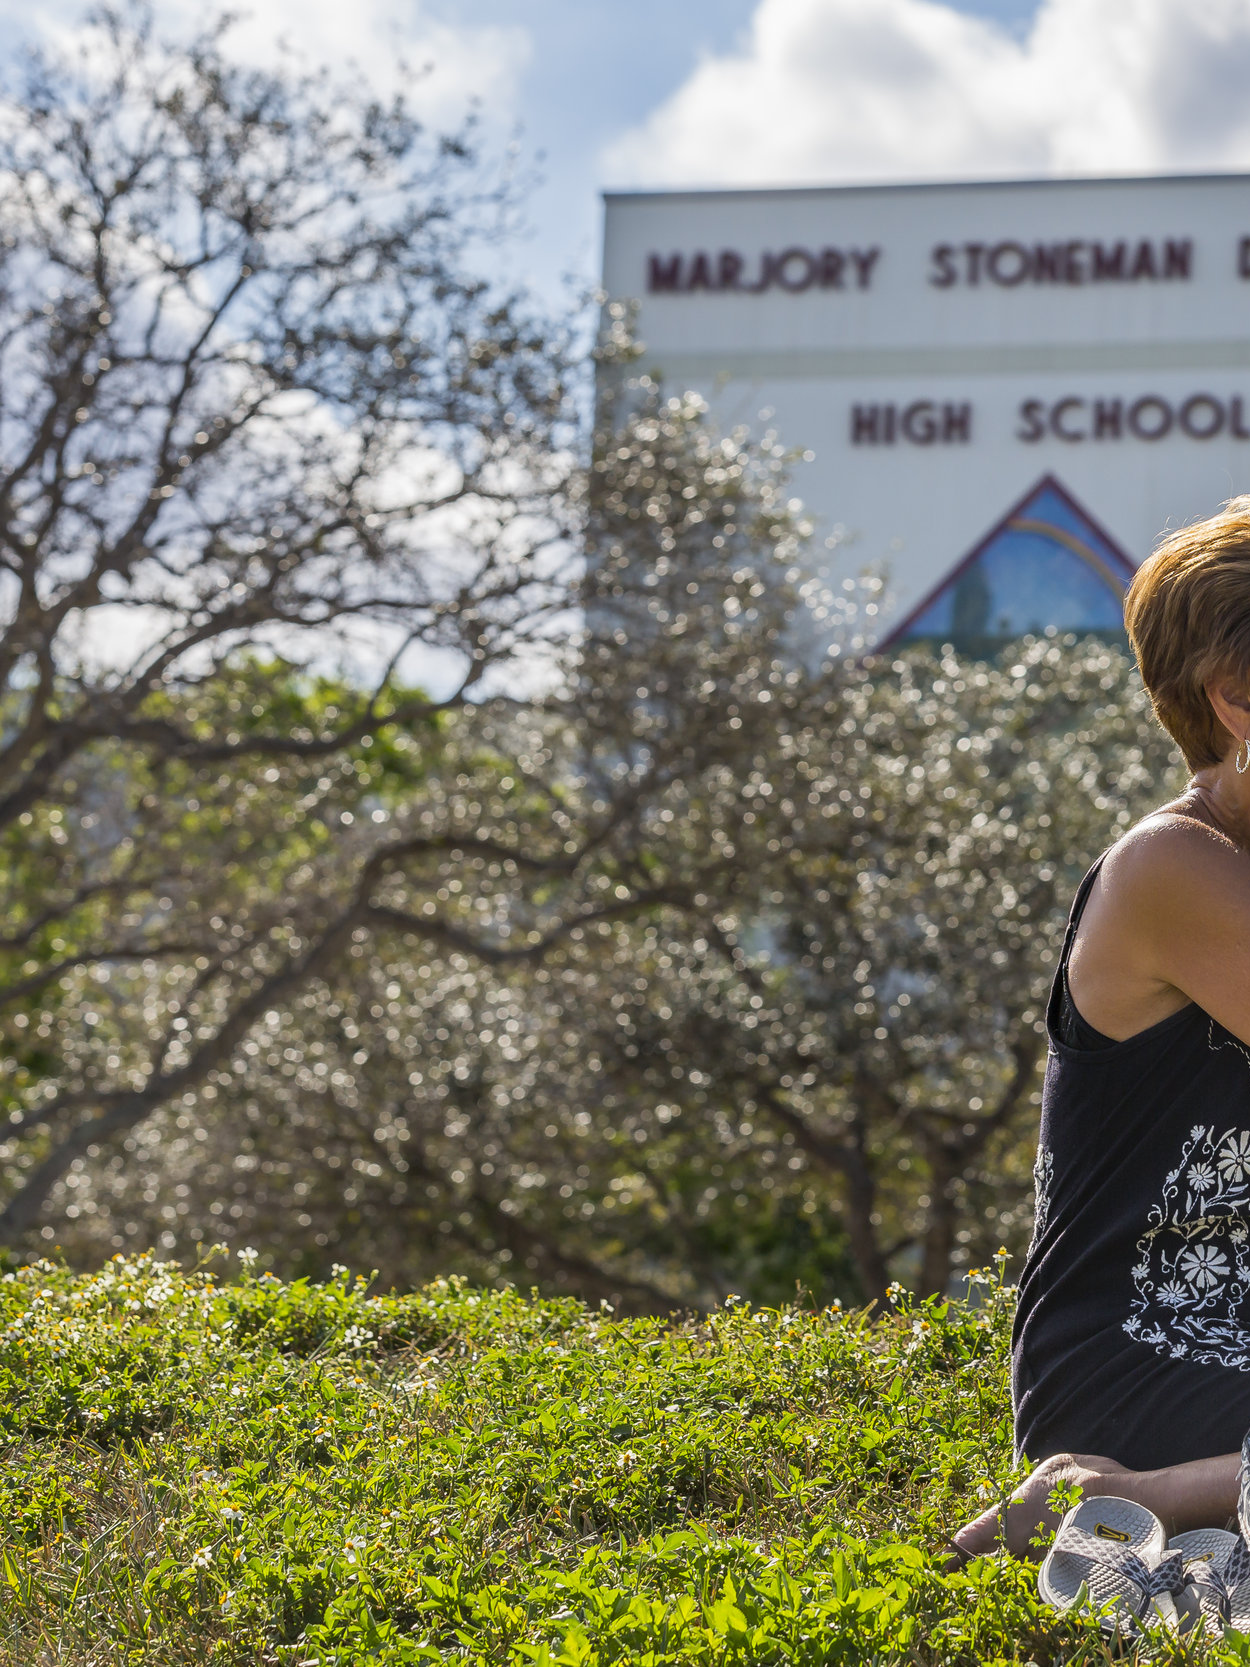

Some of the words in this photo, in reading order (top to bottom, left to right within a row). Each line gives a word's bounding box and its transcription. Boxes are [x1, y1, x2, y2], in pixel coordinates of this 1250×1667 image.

[645, 247, 881, 296] MARJORY
[929, 239, 1194, 289] STONEMAN
[850, 400, 972, 448] HIGH
